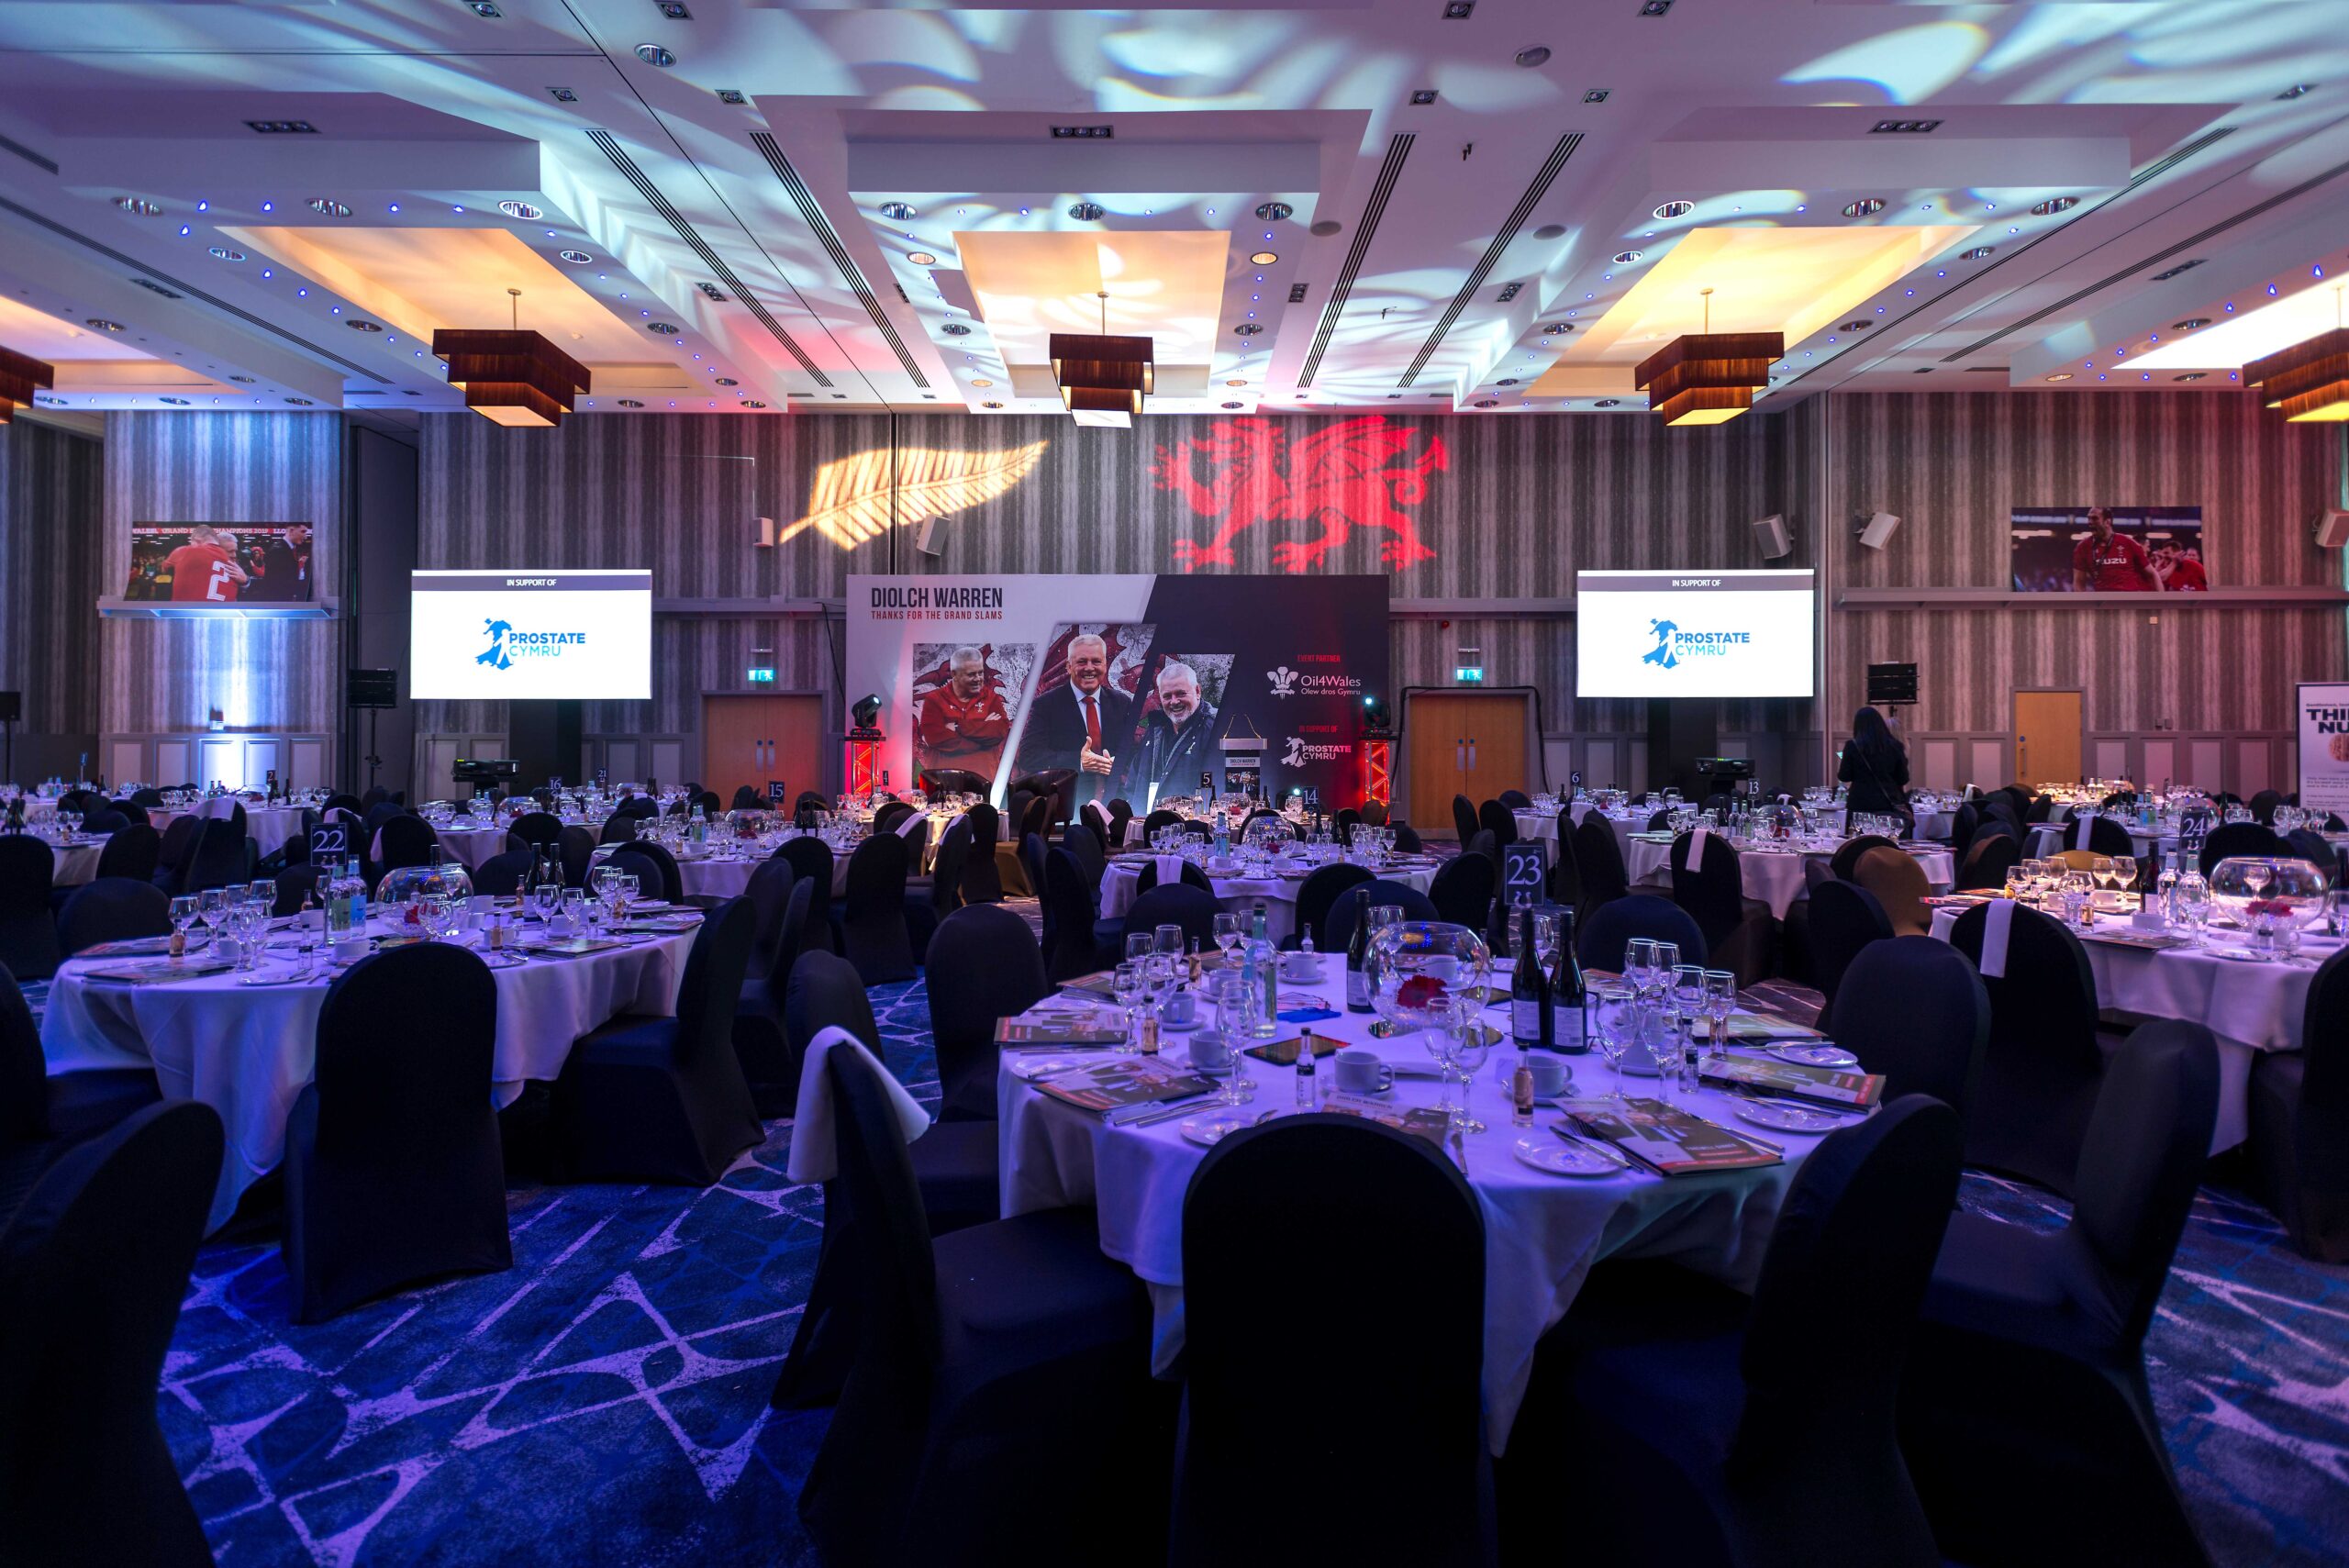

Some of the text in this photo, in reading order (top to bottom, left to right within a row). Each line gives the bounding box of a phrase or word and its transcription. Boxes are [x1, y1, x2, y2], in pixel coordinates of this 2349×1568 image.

[206, 561, 229, 602] 2
[1672, 579, 1722, 587] IN SUPPORT OF
[871, 587, 1003, 608] DIOLCH WARREN
[871, 610, 1003, 620] THANKS FOR THE GRAND SLAMS
[509, 632, 585, 644] PROSTATE
[1675, 632, 1750, 644] PROSTATE
[509, 645, 561, 657] CYMRU
[1675, 644, 1726, 656] CYMRU
[1297, 654, 1341, 662] EVENT PARTNER
[1300, 675, 1362, 687] Oil4Wales
[1300, 687, 1361, 696] Olew dros Gymru
[2306, 708, 2349, 721] THI
[1303, 745, 1352, 753] PROSTATE
[1203, 773, 1210, 785] 5
[1571, 772, 1580, 783] 6
[551, 779, 562, 790] 16
[770, 784, 784, 797] 15
[1748, 781, 1760, 795] 13
[1303, 789, 1319, 805] 14
[2181, 817, 2206, 838] 24
[313, 829, 345, 852] 22
[1508, 855, 1542, 885] 23
